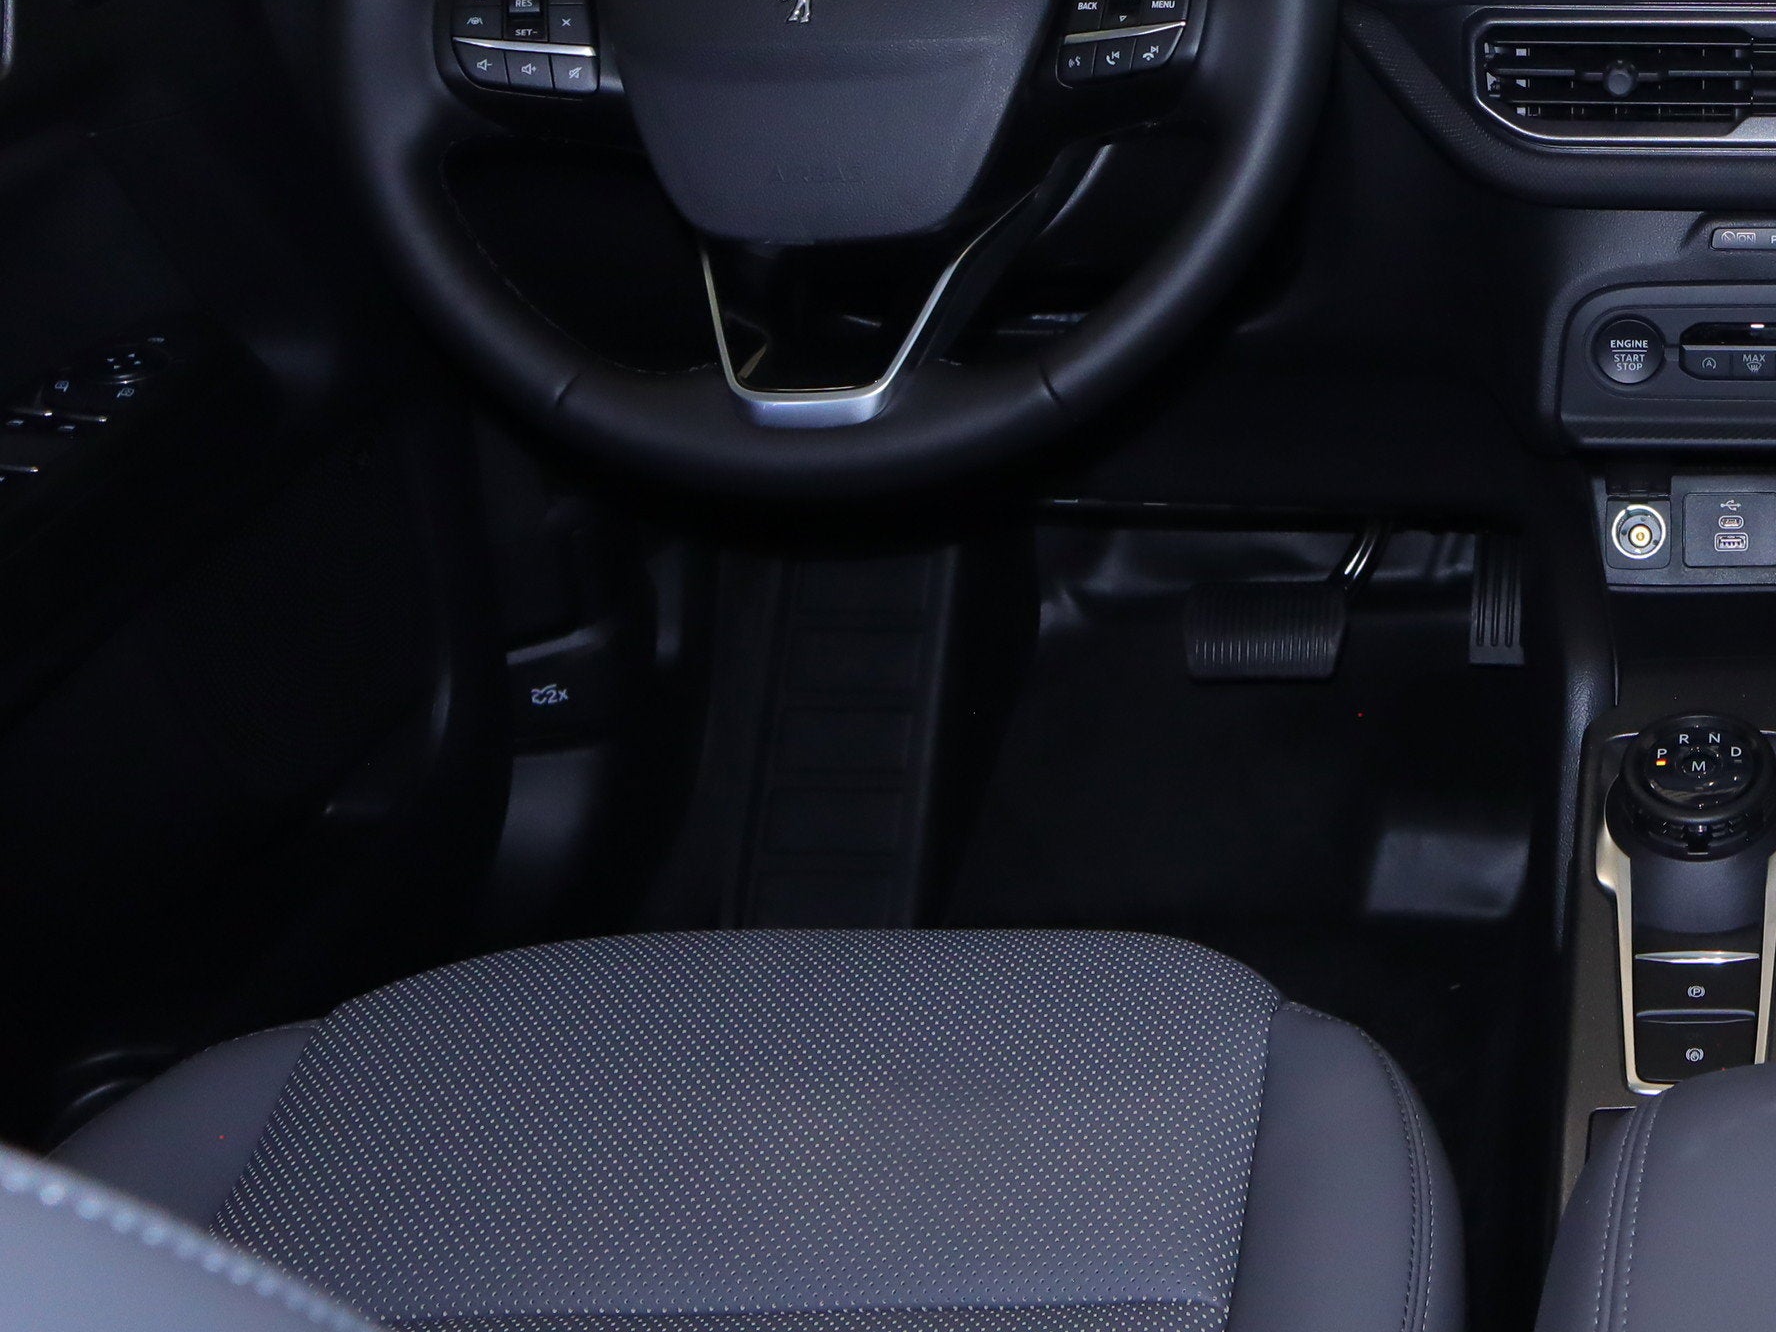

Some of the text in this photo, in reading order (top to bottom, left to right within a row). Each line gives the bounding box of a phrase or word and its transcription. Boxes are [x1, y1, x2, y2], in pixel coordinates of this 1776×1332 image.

[1077, 1, 1098, 11] BACK
[1151, 0, 1175, 9] MENU
[1610, 339, 1649, 349] ENGINE
[1613, 353, 1646, 363] START
[1742, 354, 1766, 363] MAX
[1616, 362, 1643, 371] STOP
[1679, 734, 1689, 744] R
[1708, 733, 1720, 743] N
[1657, 749, 1668, 759] P
[1730, 746, 1742, 757] D
[1691, 761, 1706, 771] M
